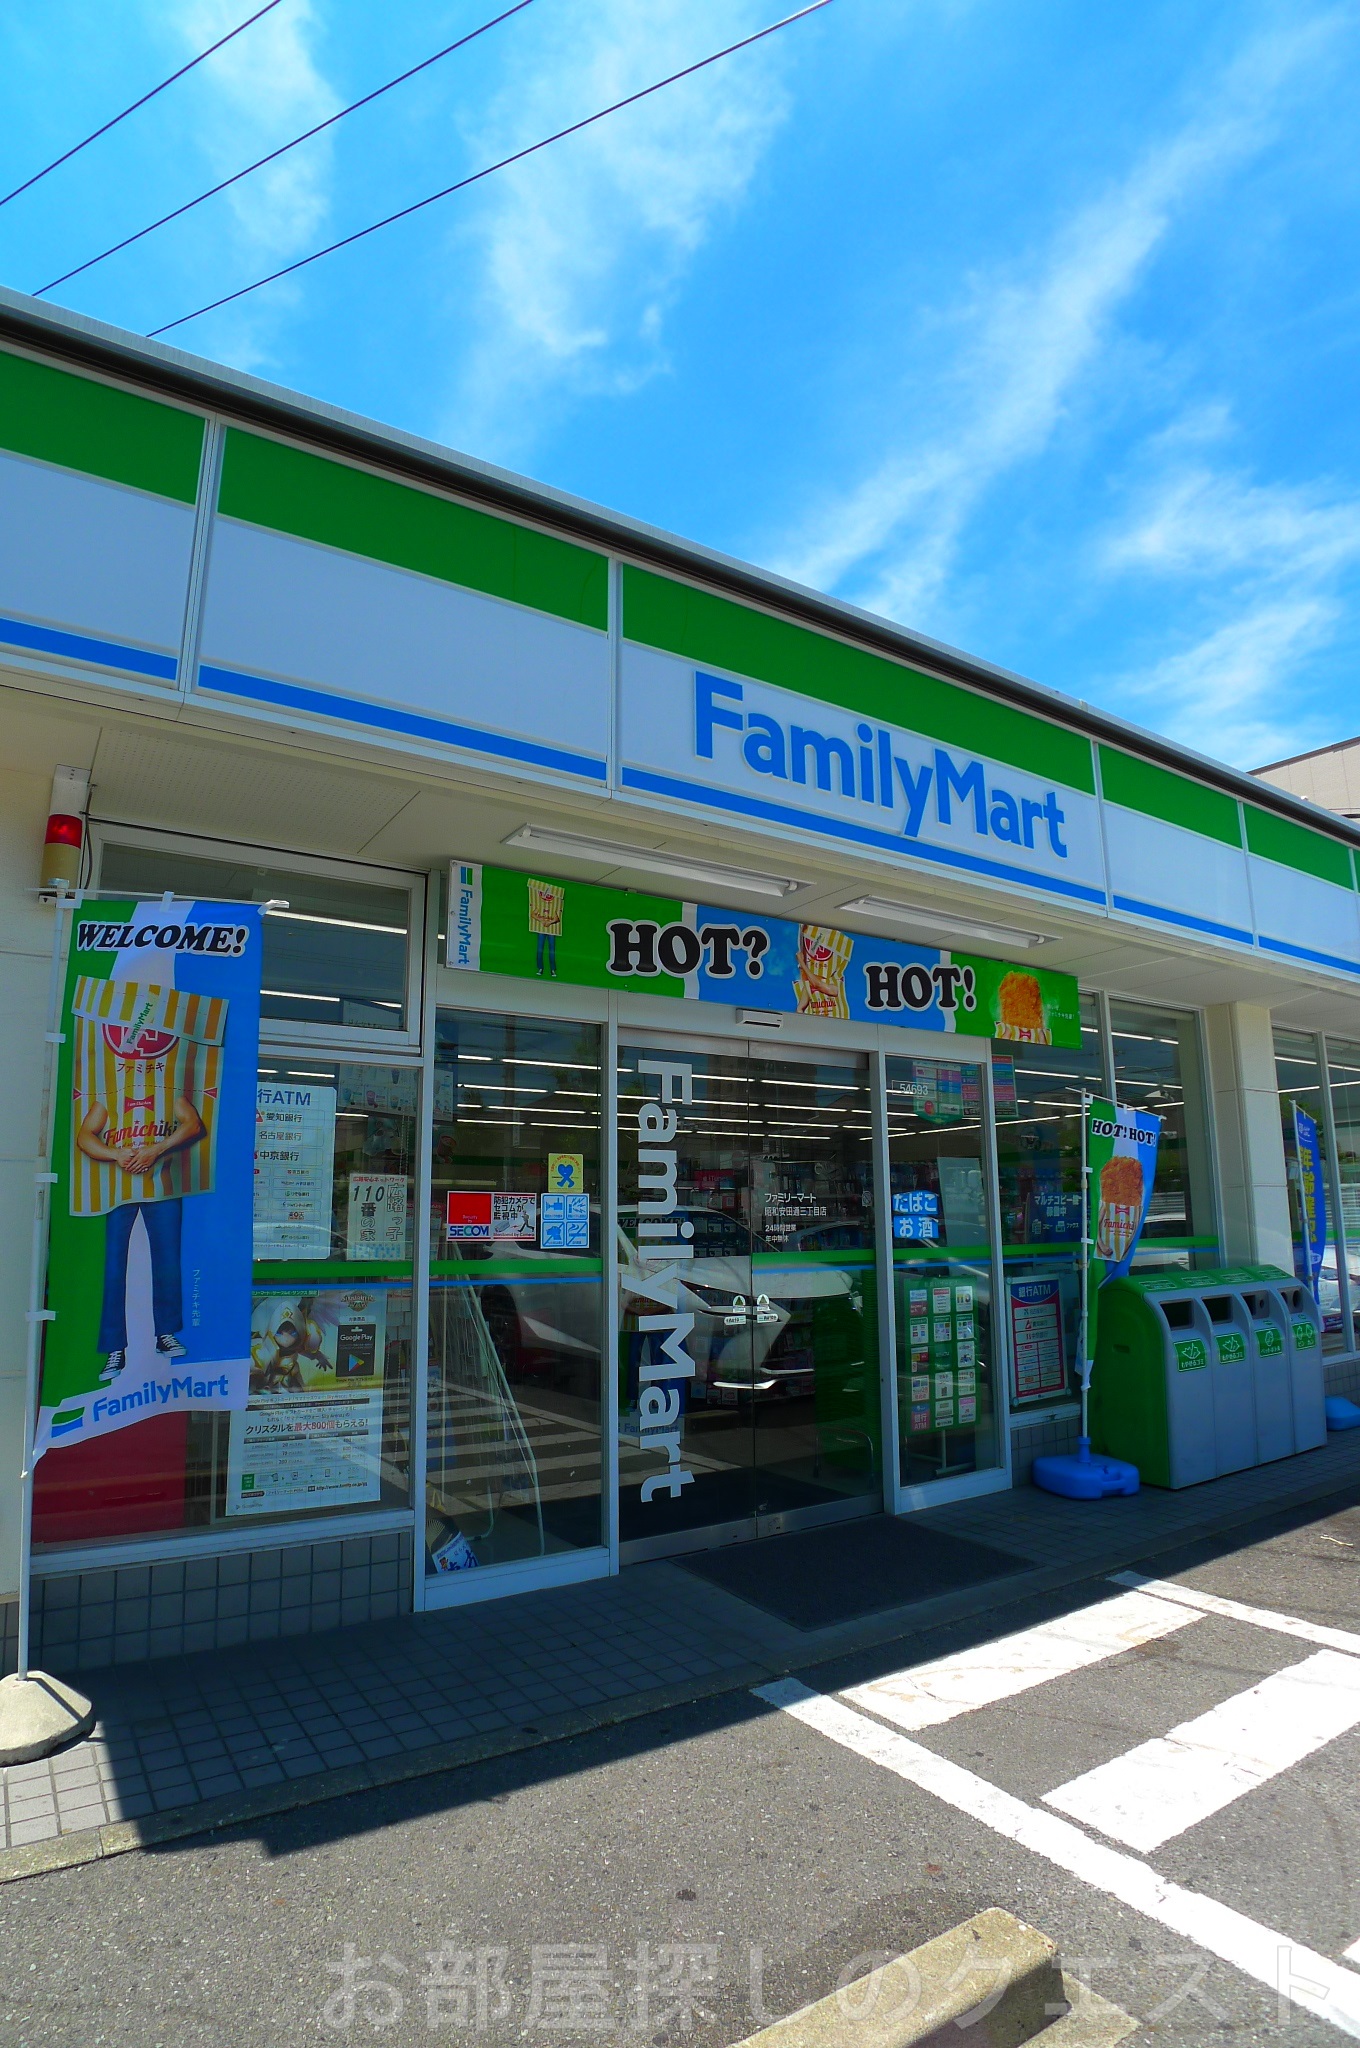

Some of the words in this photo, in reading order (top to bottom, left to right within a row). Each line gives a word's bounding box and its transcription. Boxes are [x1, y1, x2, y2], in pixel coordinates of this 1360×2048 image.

[695, 671, 1068, 858] FamilyMart
[458, 889, 474, 965] FamilyMart
[77, 923, 247, 954] WELCOME!
[608, 921, 769, 978] HOT?
[865, 963, 976, 1011] HOT!
[126, 1002, 154, 1044] FamilyMart
[117, 1062, 165, 1074] ファミチキ
[899, 1083, 929, 1096] 54693
[266, 1112, 303, 1123] 愛知銀行
[259, 1131, 302, 1141] 名古屋銀行
[1092, 1120, 1127, 1138] HOT!
[259, 1150, 300, 1161] 中京銀行
[494, 1196, 535, 1205] 防犯カメラで
[765, 1193, 816, 1203] ファミリーマート
[893, 1194, 937, 1212] たばこ
[494, 1205, 524, 1213] セコムが
[494, 1212, 518, 1220] 監視中
[449, 1225, 489, 1236] SECOM
[899, 1217, 933, 1238] お酒
[620, 1059, 696, 1502] FamilyMart
[1018, 1285, 1051, 1298] 銀行ATM
[340, 1334, 360, 1342] Google
[361, 1333, 373, 1341] Play
[92, 1375, 228, 1422] FamilyMart
[246, 1419, 368, 1434] クリスタルを最大800個もらえる!
